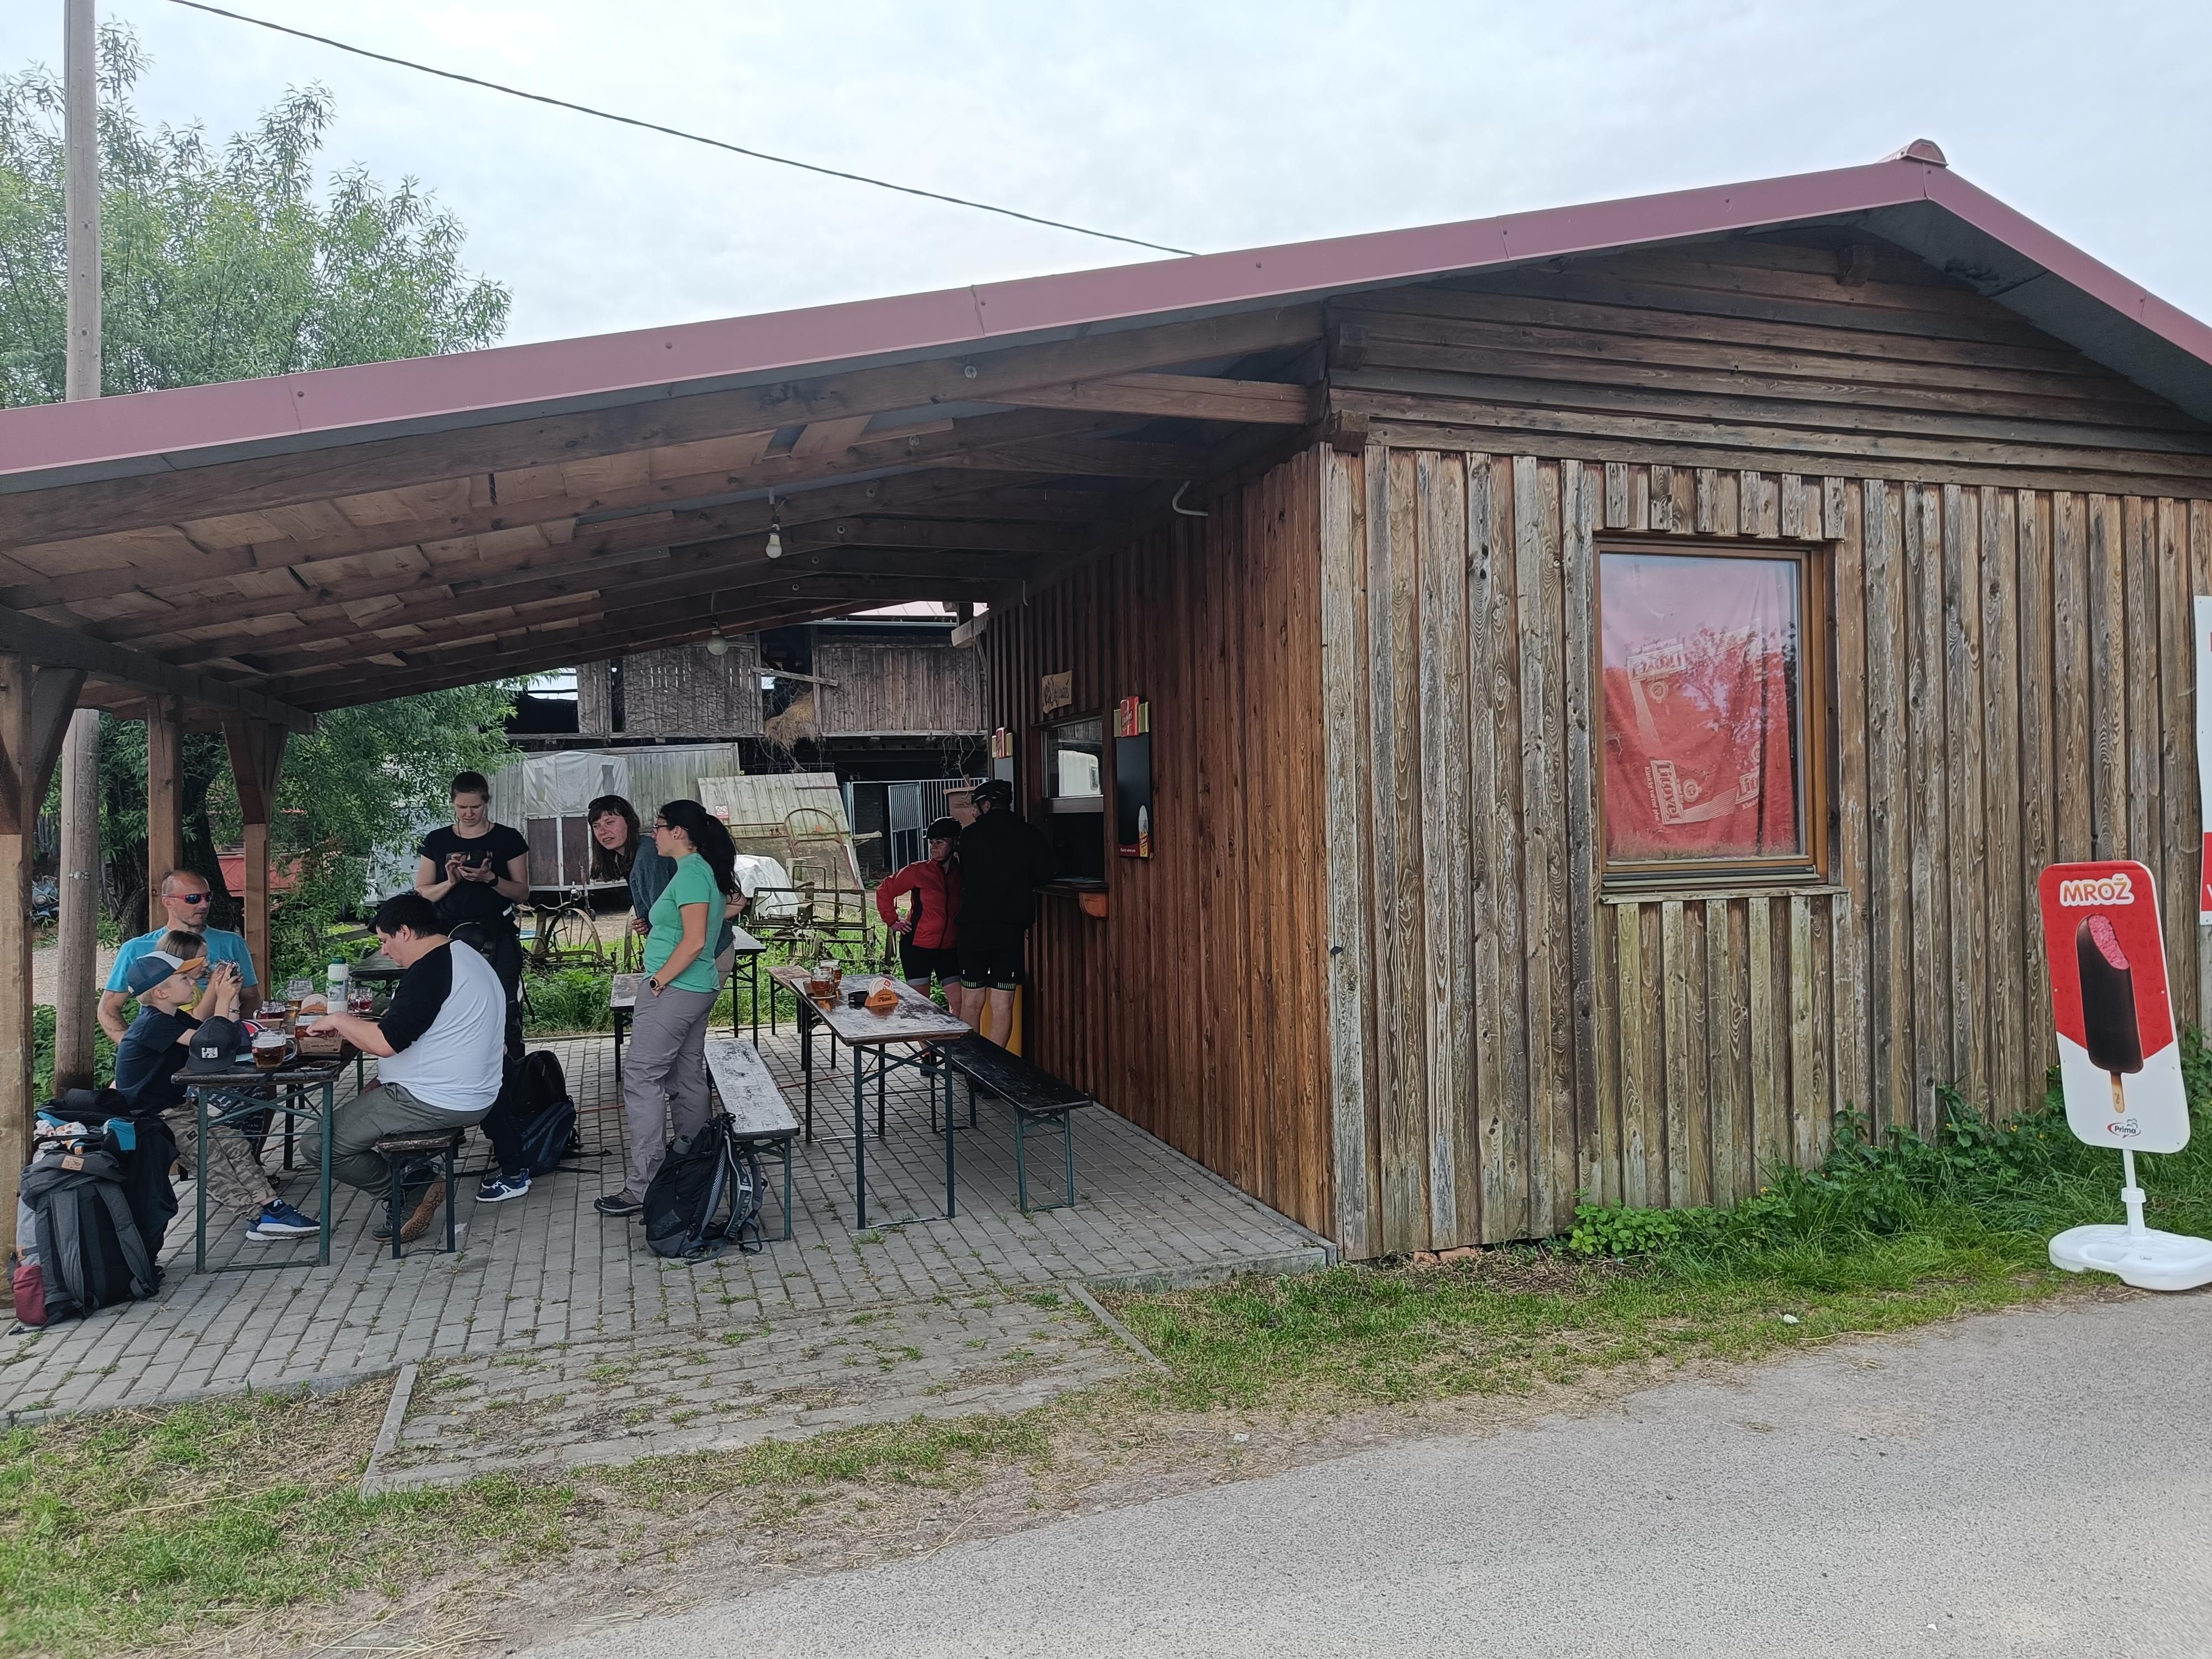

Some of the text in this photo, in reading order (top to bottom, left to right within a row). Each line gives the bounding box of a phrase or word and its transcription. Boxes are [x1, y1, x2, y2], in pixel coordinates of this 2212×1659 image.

[1657, 763, 1682, 820] Litovel
[2063, 877, 2131, 902] MROŽ
[2114, 1125, 2137, 1134] Prima
